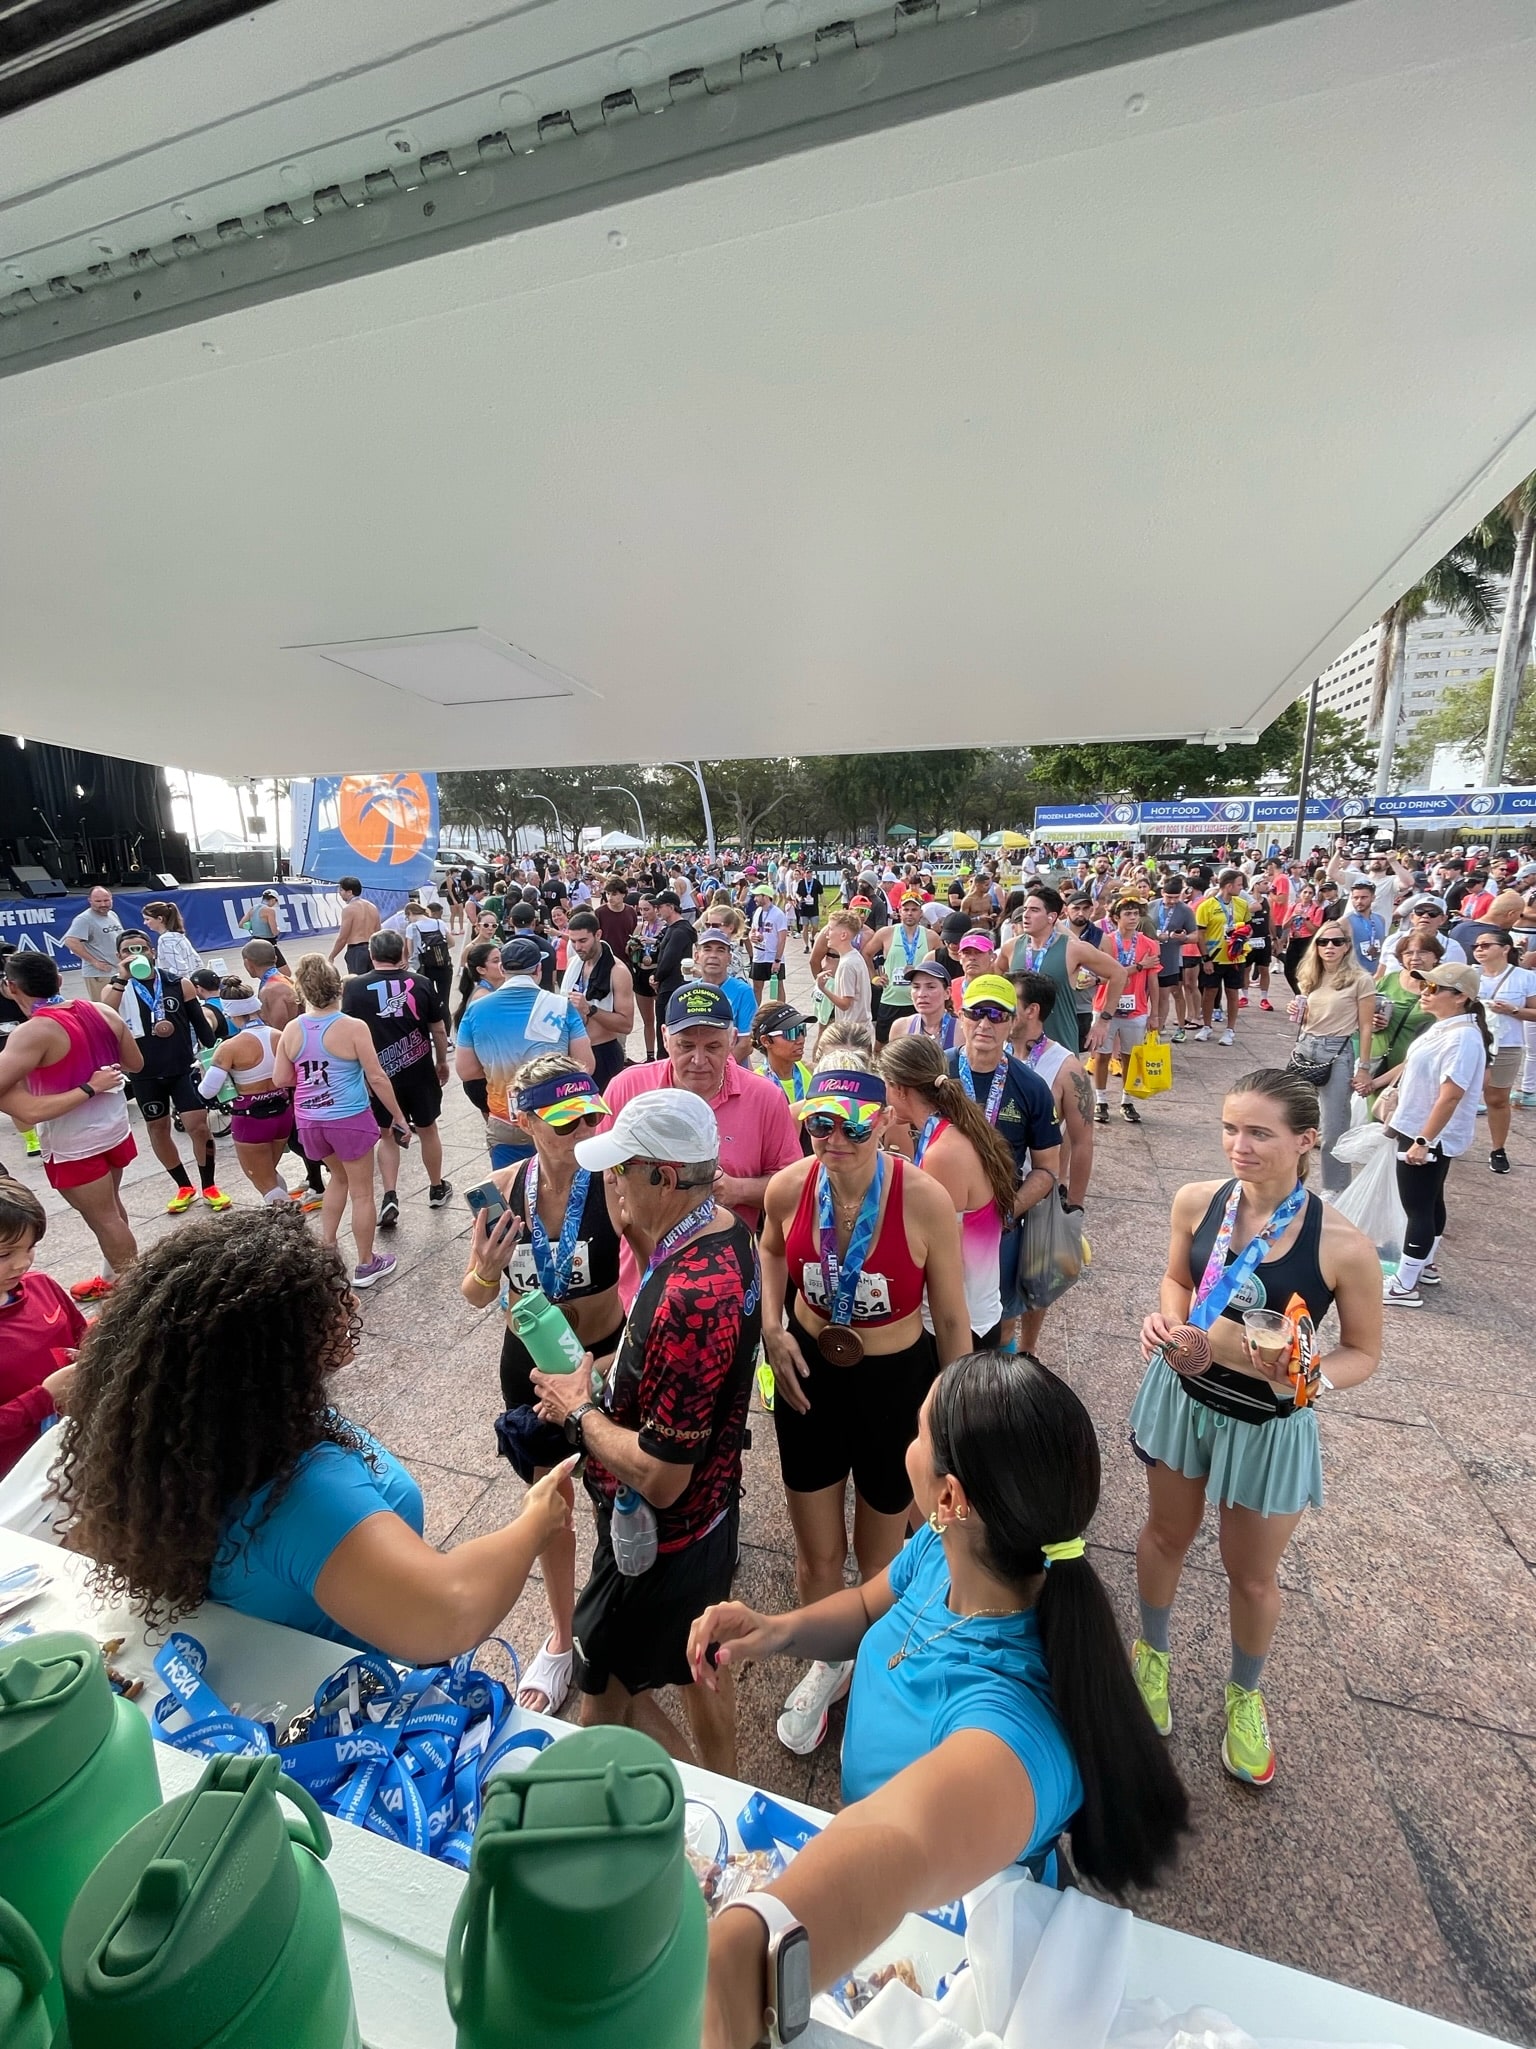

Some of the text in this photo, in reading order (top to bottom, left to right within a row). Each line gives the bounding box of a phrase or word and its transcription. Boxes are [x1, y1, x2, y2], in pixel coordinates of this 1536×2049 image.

[1379, 800, 1448, 810] COLD DRINKS
[1512, 799, 1536, 807] COL
[1064, 812, 1099, 820] LEMONADE
[1151, 806, 1201, 815] HOT FOOD
[1257, 805, 1321, 816] HOT COFEE
[1460, 833, 1534, 844] COLD BEER
[678, 991, 692, 1003] MAX
[163, 1655, 200, 1700] HOKA
[384, 1692, 418, 1729] HOKA
[410, 1713, 458, 1727] FLY HUMAN
[335, 1740, 388, 1762] HOKA
[351, 1770, 372, 1806] HUMAN
